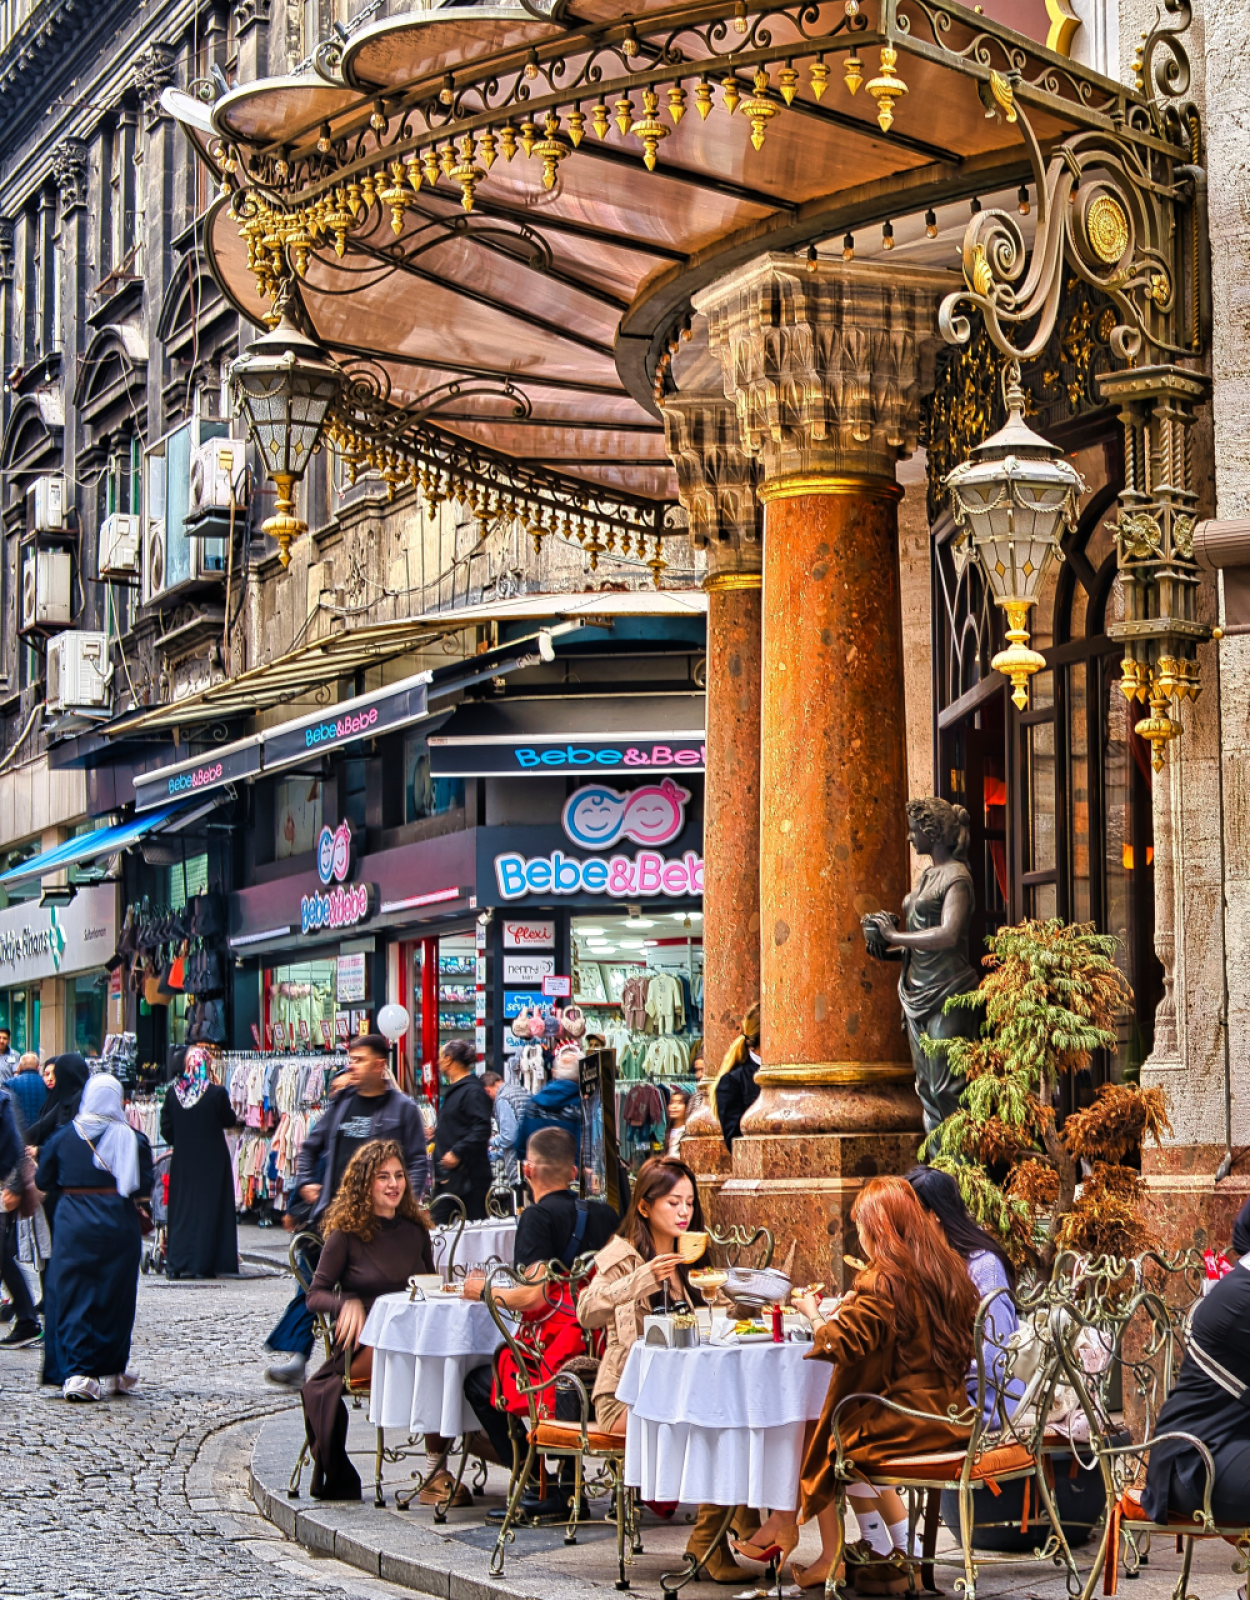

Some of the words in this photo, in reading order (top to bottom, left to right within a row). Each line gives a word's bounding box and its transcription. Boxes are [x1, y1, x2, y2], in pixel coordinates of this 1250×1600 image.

[305, 708, 378, 747] Bebe&Bebe
[514, 746, 706, 768] Bebe&Be
[168, 763, 223, 794] Bebe&Bebe
[301, 883, 367, 935] Bebe&Bebe
[507, 924, 553, 944] flexi
